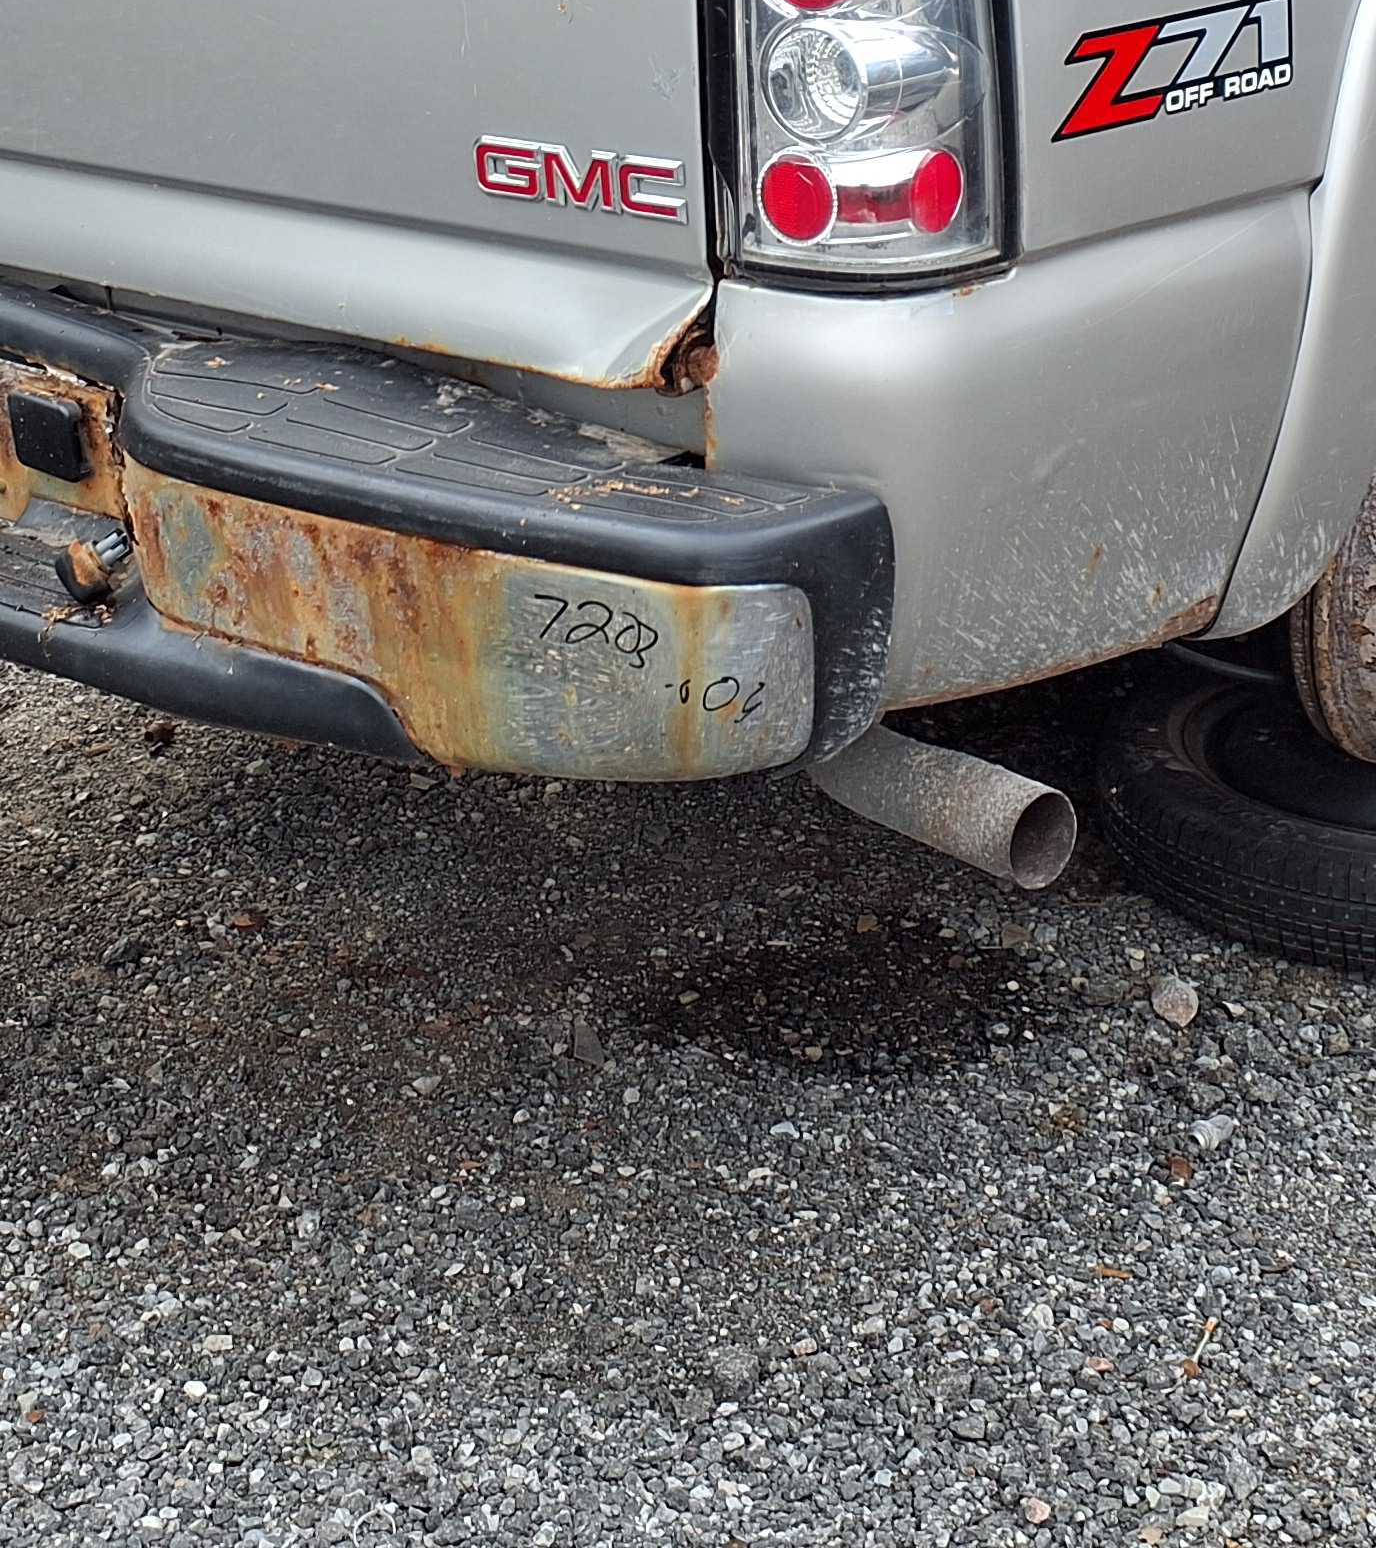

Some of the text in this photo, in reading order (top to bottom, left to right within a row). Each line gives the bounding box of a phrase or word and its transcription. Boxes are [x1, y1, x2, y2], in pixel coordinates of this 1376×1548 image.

[1164, 62, 1292, 114] OFF ROAD
[473, 134, 688, 226] GMC
